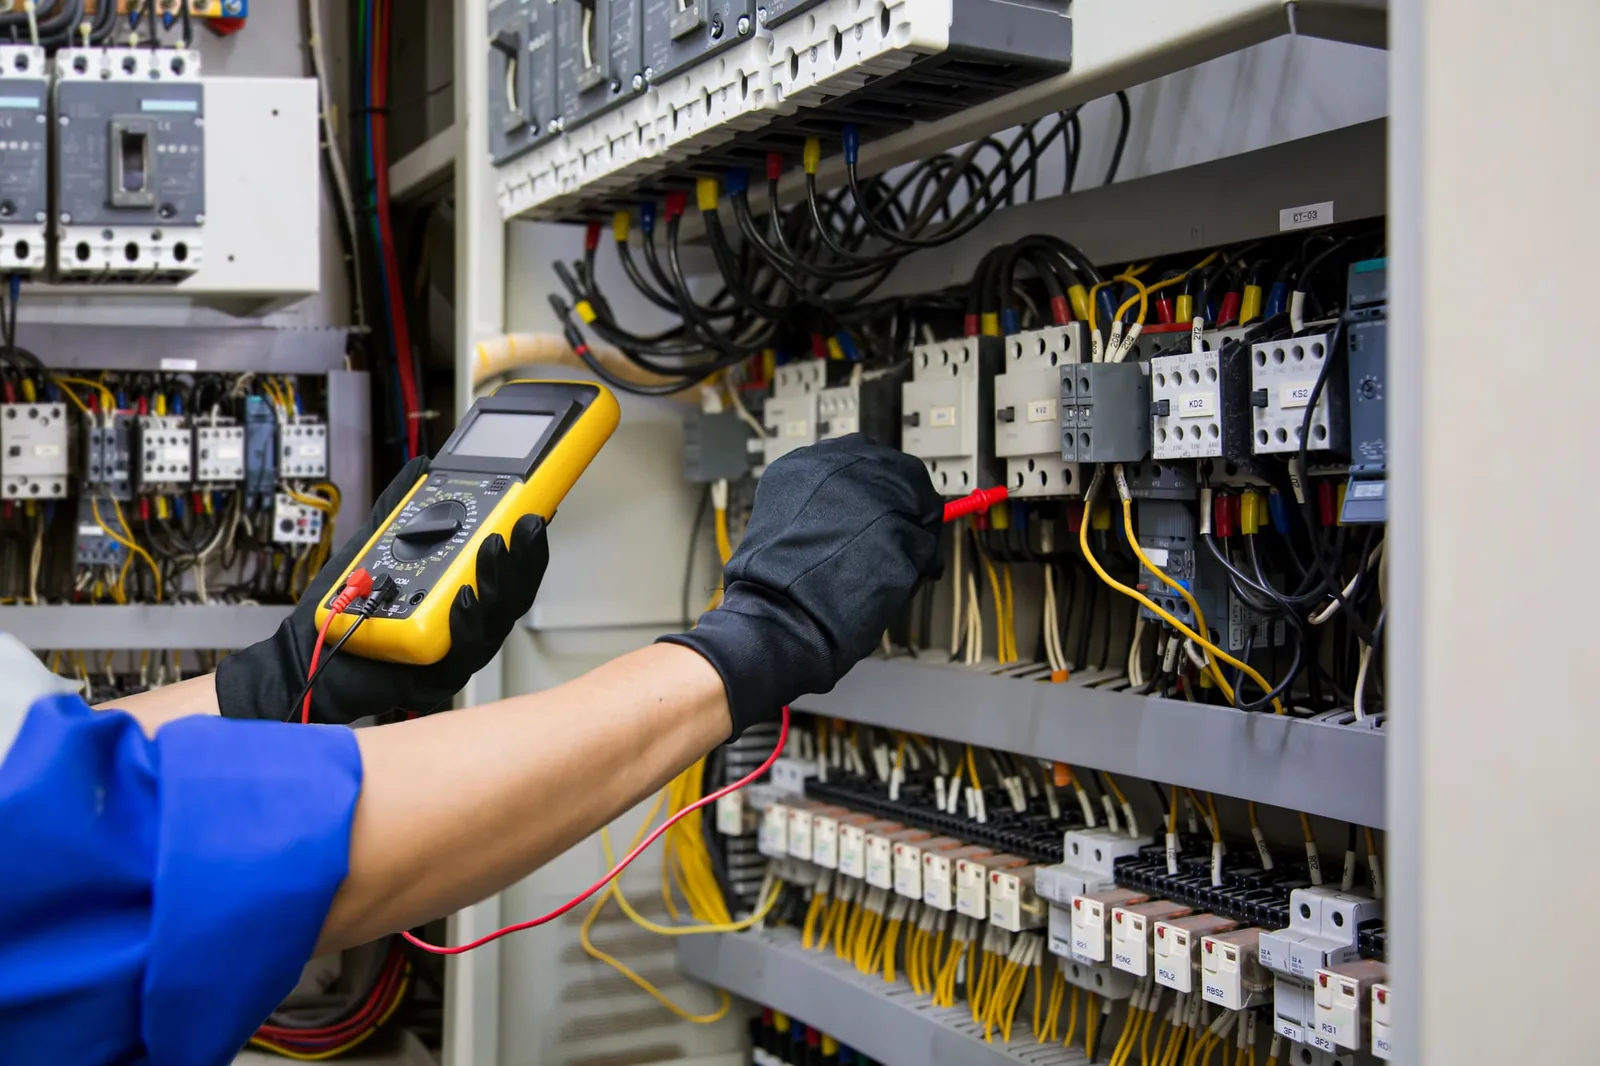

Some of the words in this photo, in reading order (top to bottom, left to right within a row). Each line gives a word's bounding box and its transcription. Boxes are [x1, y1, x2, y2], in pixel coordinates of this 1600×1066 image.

[1293, 210, 1317, 222] CT-03
[1193, 326, 1202, 340] 212
[1292, 389, 1308, 398] KS2
[1189, 399, 1203, 408] KD2
[1206, 985, 1224, 999] RBS2
[1283, 1026, 1296, 1038] 3F1
[1321, 1023, 1337, 1035] R31
[1314, 1036, 1330, 1049] 3F2
